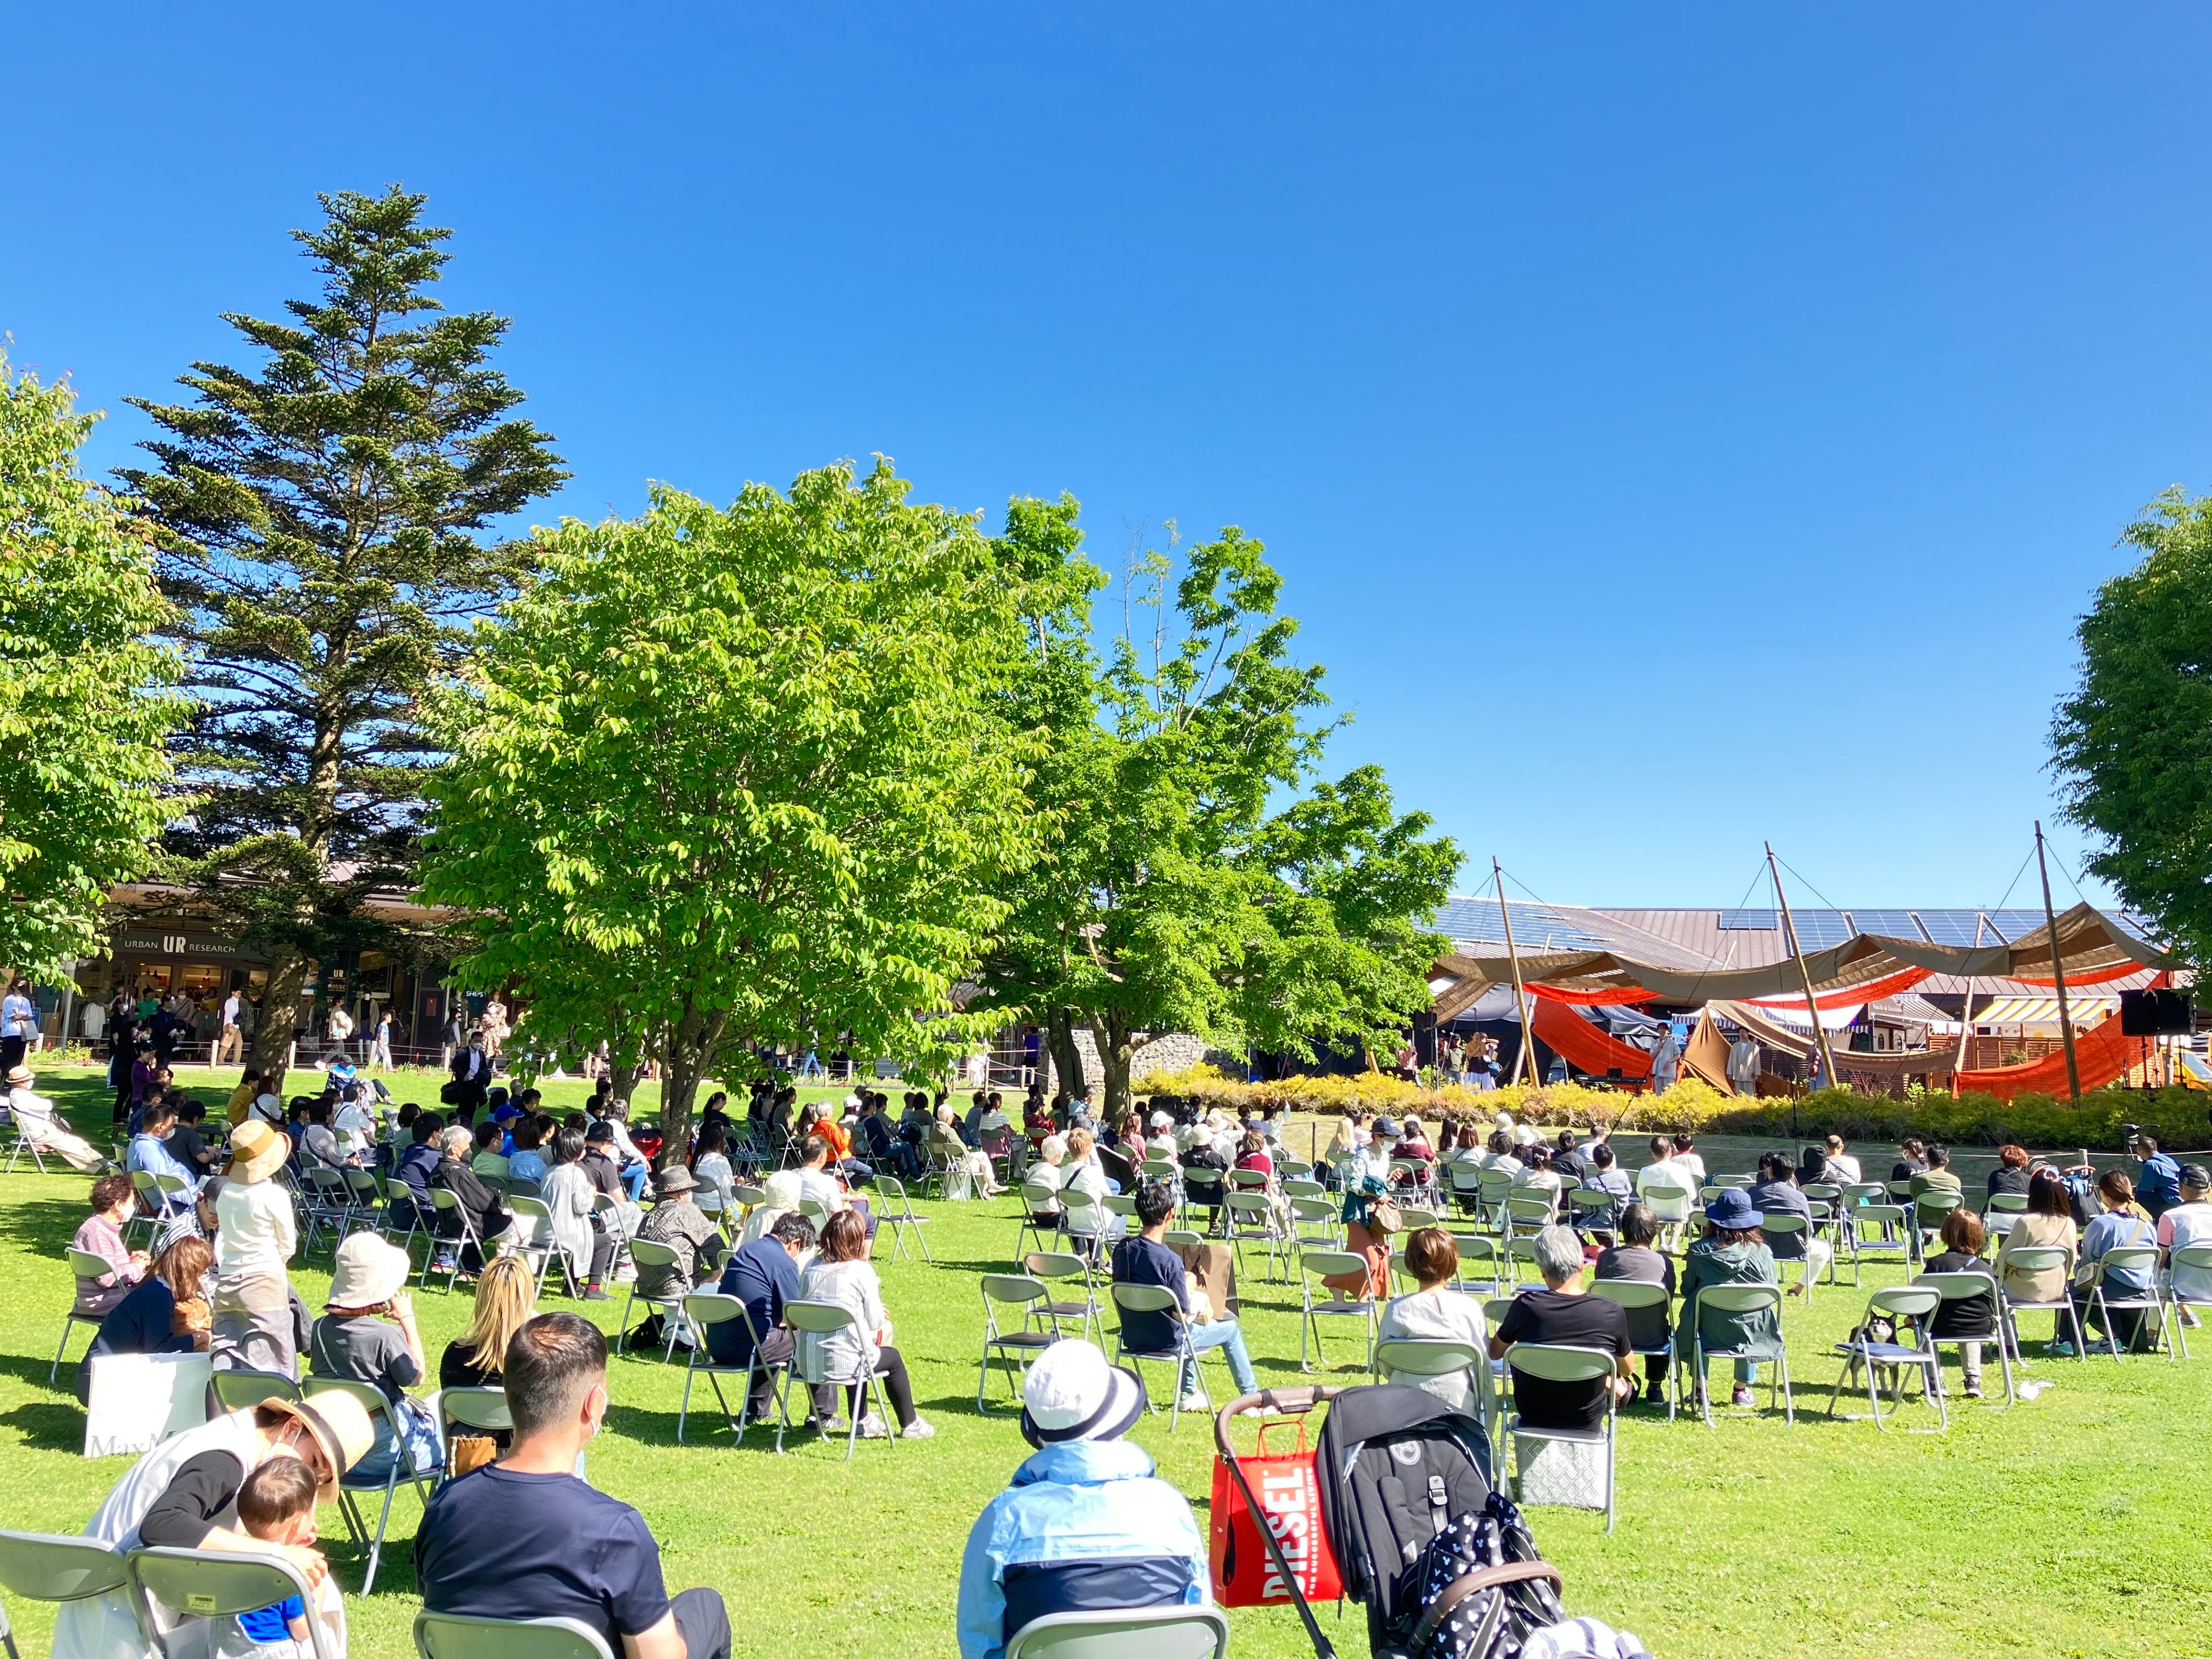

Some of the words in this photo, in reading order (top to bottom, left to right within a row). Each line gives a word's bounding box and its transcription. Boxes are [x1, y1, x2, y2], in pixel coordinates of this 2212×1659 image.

[125, 940, 158, 949] URBAN
[163, 936, 186, 953] UR
[189, 944, 235, 953] RESEARCH
[1306, 1467, 1316, 1503] LIVING
[1263, 1468, 1308, 1598] DIESEL
[1308, 1576, 1317, 1595] FOR
